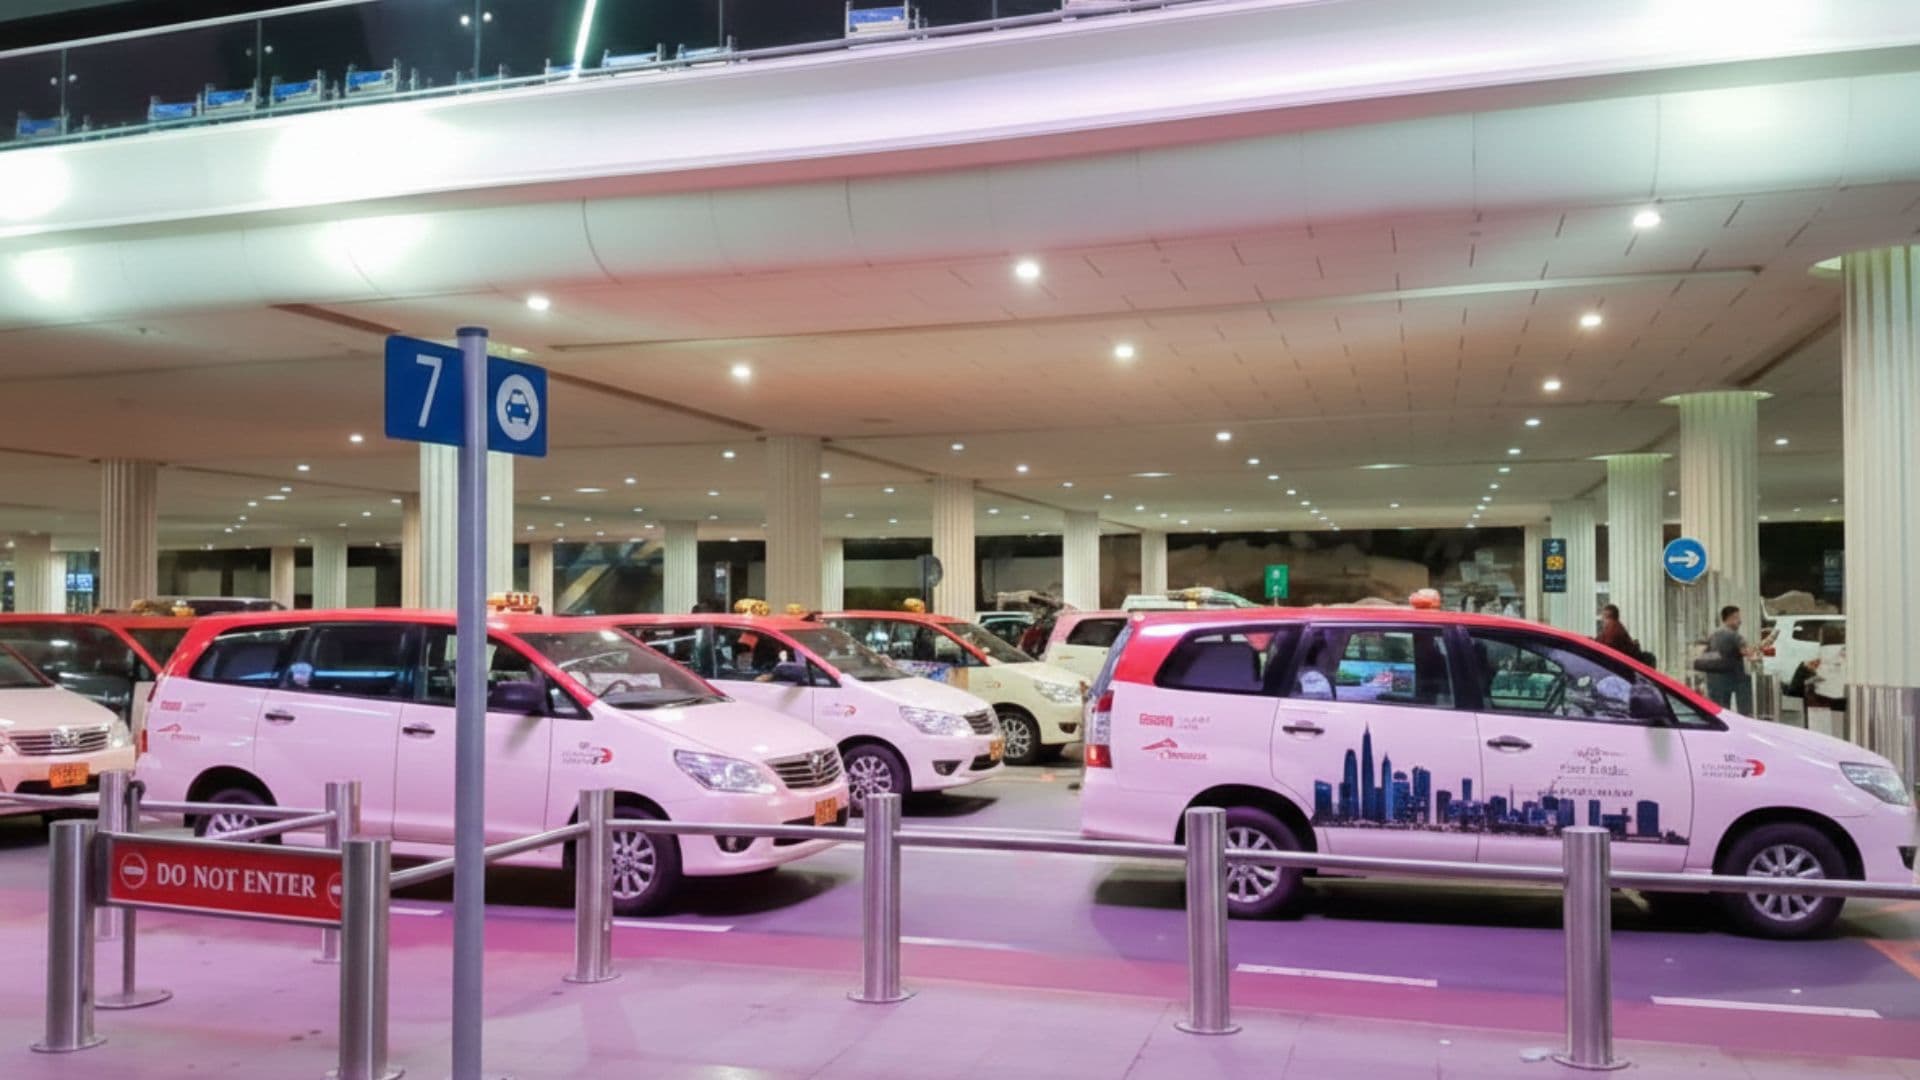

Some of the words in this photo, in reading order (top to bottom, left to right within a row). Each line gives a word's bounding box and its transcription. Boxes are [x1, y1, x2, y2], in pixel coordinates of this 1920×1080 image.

[416, 354, 443, 428] 7
[157, 863, 186, 886] DO
[193, 866, 239, 892] NOT
[243, 870, 316, 898] ENTER
